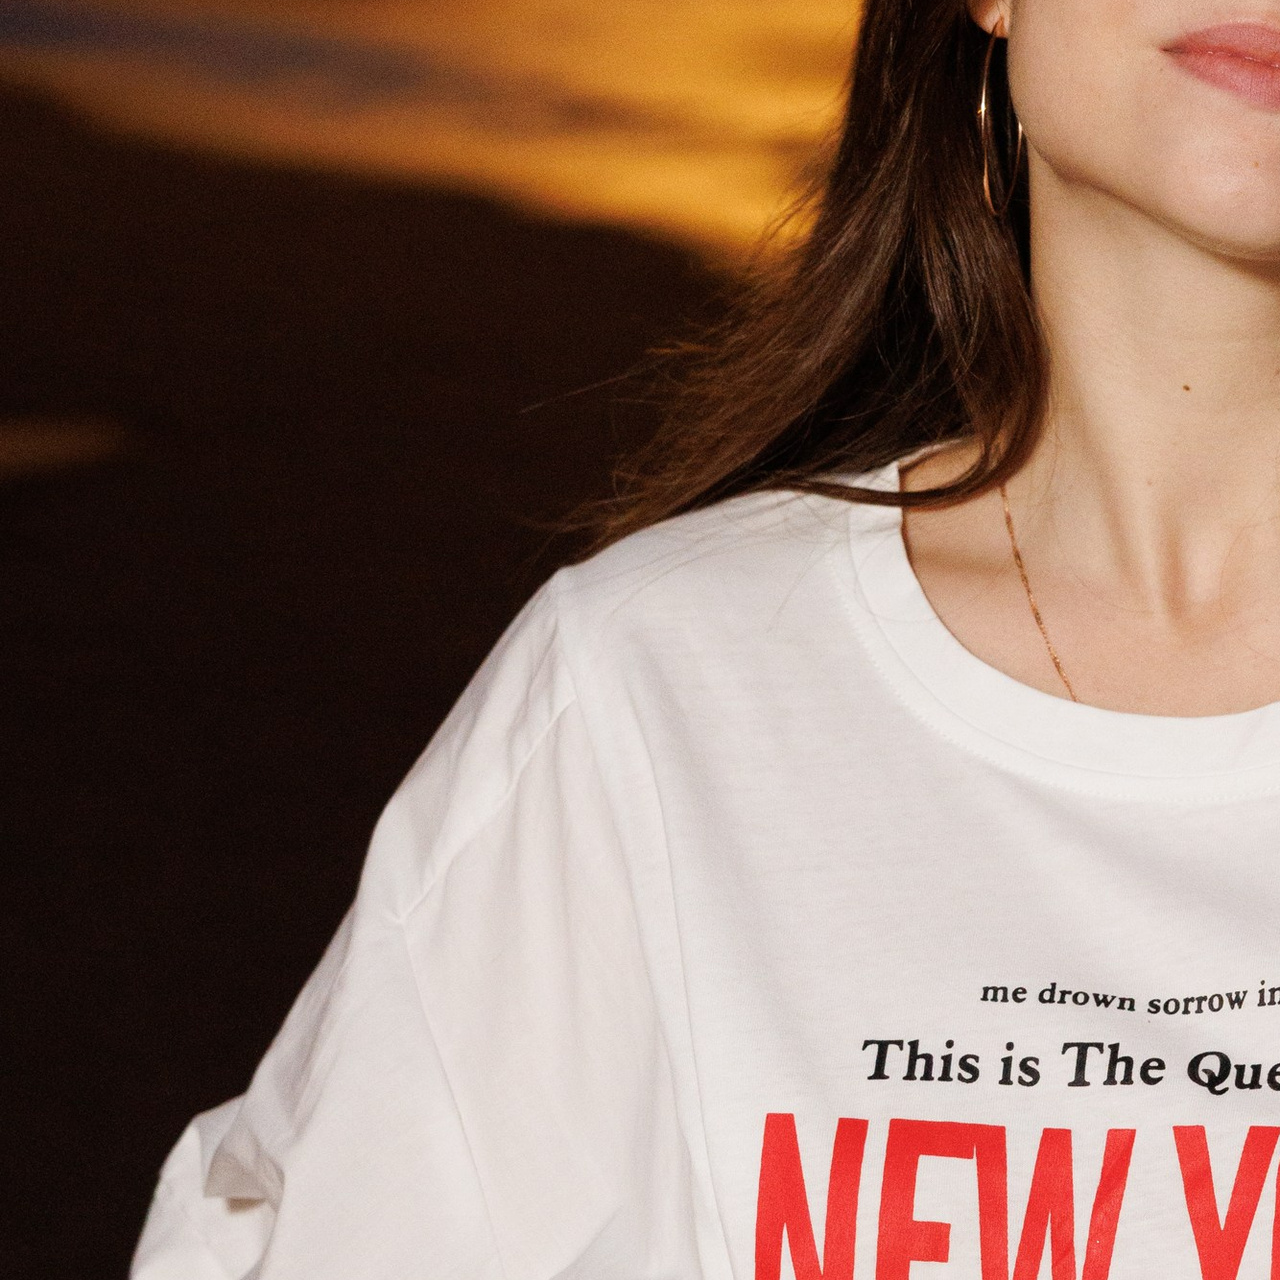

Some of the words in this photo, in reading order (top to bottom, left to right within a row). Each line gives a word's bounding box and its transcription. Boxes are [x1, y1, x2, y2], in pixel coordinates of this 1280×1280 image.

[980, 986, 1028, 1004] me
[1038, 981, 1136, 1012] drown
[1147, 985, 1248, 1016] sorrow
[862, 1038, 980, 1085] This
[999, 1041, 1041, 1088] is
[1061, 1041, 1166, 1088] The
